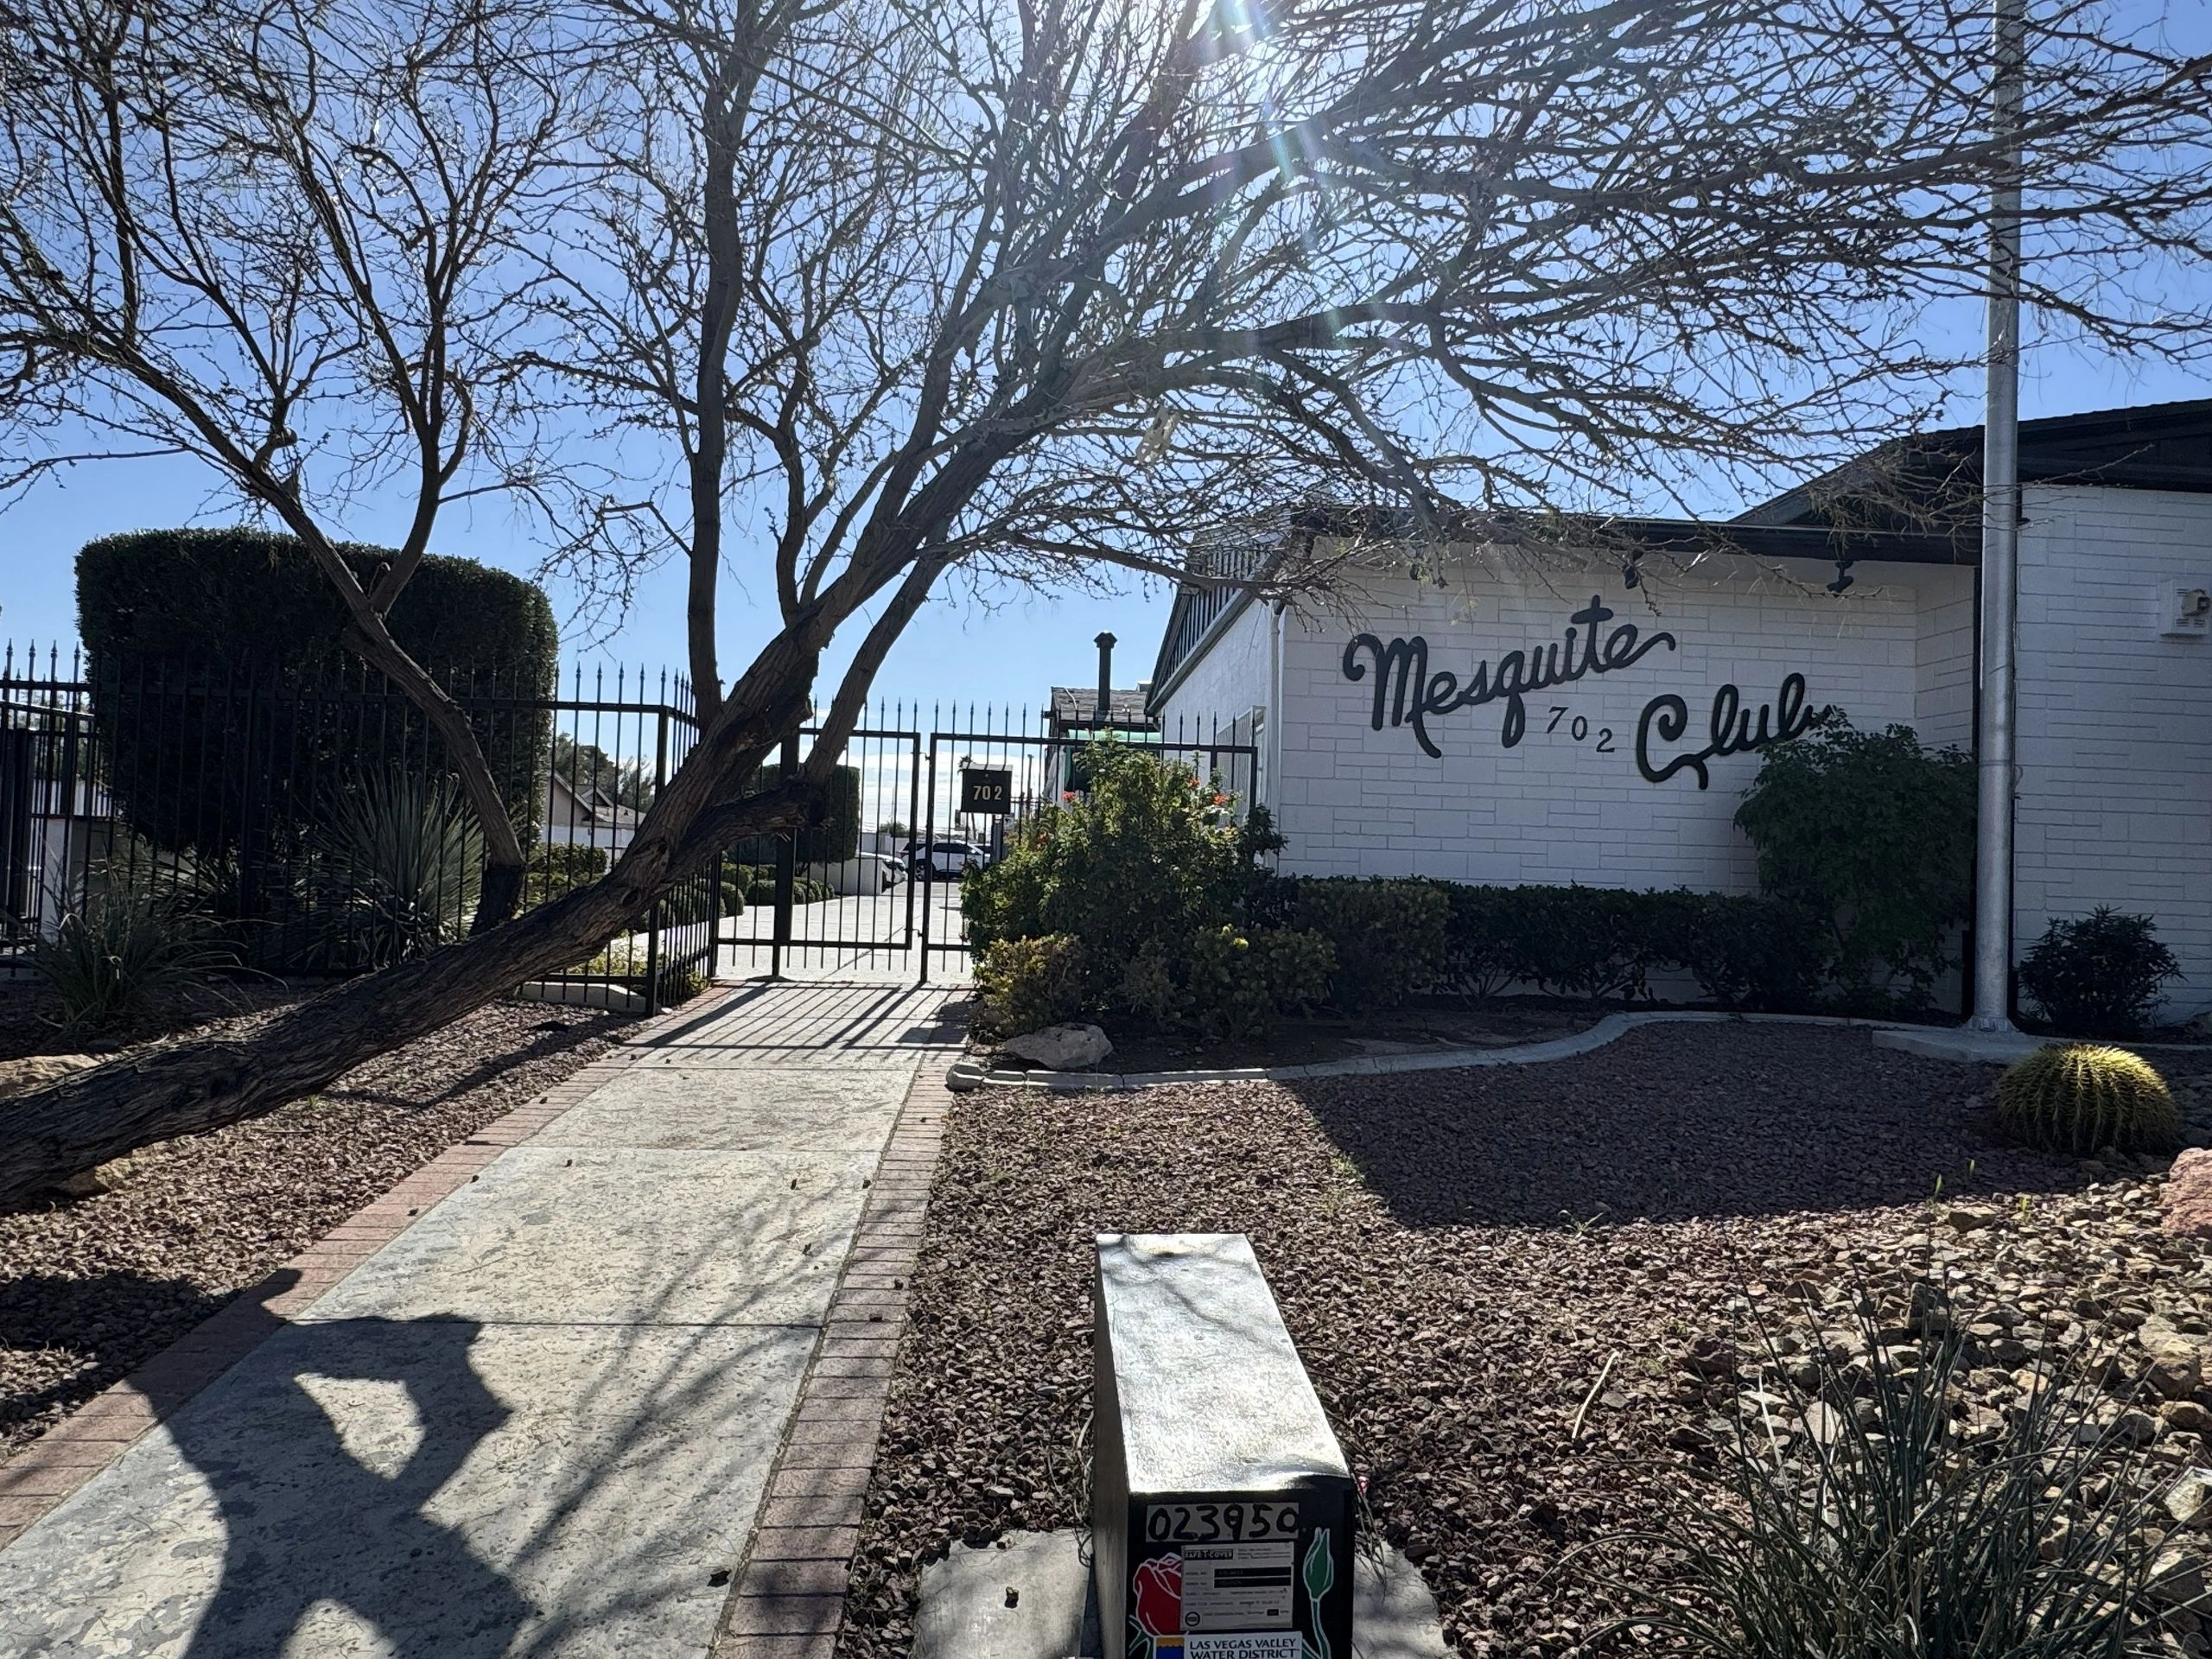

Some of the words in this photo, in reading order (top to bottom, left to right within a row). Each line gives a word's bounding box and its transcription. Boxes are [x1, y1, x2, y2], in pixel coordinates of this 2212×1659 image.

[1343, 594, 1675, 759] Mesquite
[1547, 706, 1615, 753] 702
[1636, 672, 1834, 791] Club
[973, 785, 1002, 800] 702
[1148, 1504, 1298, 1541] 023950
[1190, 1641, 1211, 1649] LAS
[1213, 1639, 1252, 1649] VEGAS
[1255, 1638, 1296, 1648] VALLEY
[1190, 1650, 1235, 1659] WATER
[1239, 1649, 1300, 1659] DISTRICT
